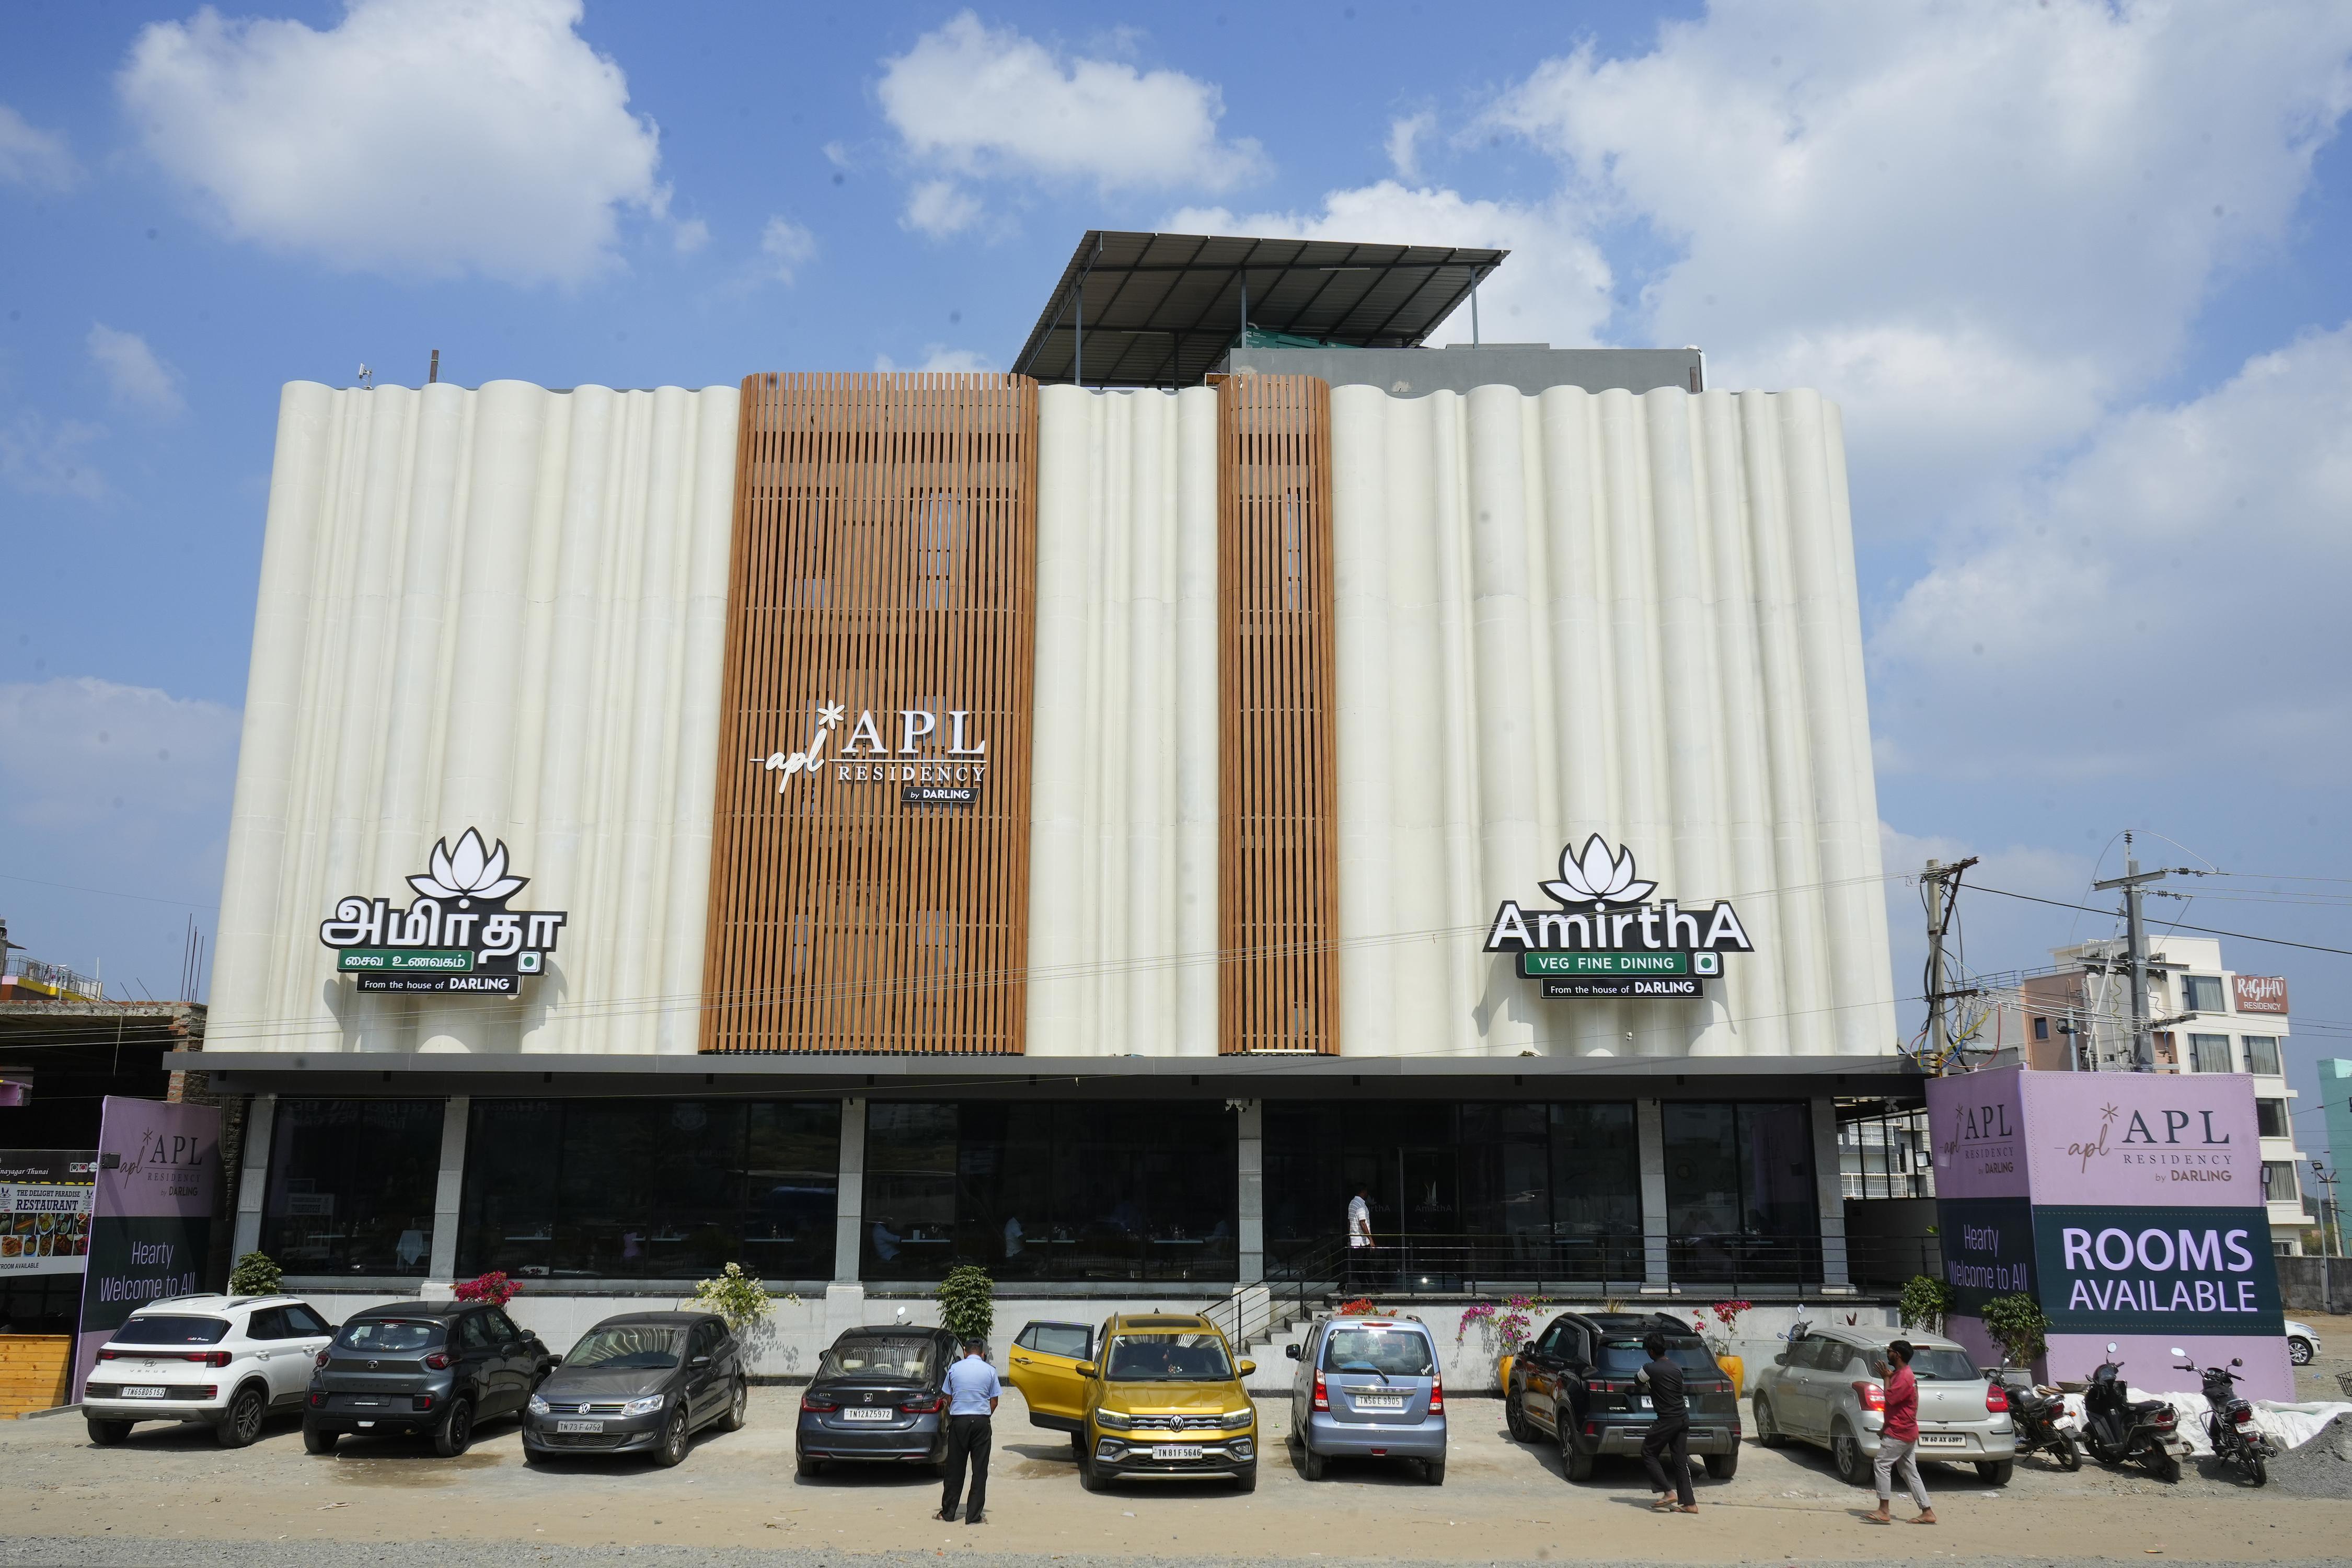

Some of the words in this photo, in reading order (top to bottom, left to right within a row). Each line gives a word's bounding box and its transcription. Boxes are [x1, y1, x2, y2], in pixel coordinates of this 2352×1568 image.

[840, 709, 986, 754] APL
[765, 728, 828, 794] apl
[838, 766, 986, 782] RESIDENCY
[910, 791, 919, 800] by
[923, 789, 970, 799] DARLING
[321, 897, 563, 965] அமிர்தா
[1489, 902, 1750, 949] AmirthA
[345, 954, 384, 967] சைவ
[391, 953, 466, 969] உணவகம்
[1538, 957, 1569, 969] VEG
[1578, 957, 1612, 969] FINE
[1621, 957, 1675, 969] DINING
[389, 981, 403, 989] the
[407, 981, 432, 989] house
[435, 981, 444, 989] of
[449, 977, 510, 990] DARLING
[1550, 985, 1572, 994] From
[1575, 985, 1589, 994] the
[1592, 985, 1617, 994] house
[1620, 985, 1630, 994] of
[1634, 981, 1695, 994] DARLING
[2237, 978, 2284, 1001] RAGHAV
[2244, 1001, 2281, 1010] RESIDENCY
[1964, 1104, 2012, 1139] APL
[2122, 1110, 2230, 1144] APL
[149, 1134, 203, 1166] APL
[1965, 1147, 2013, 1159] RESIDENCY
[2068, 1123, 2110, 1174] apl
[1985, 1162, 2013, 1174] DARLING
[2124, 1154, 2232, 1165] RESIDENCY
[0, 1168, 26, 1177] nayagar
[147, 1172, 201, 1183] RESIDENCY
[2155, 1173, 2166, 1183] by
[2171, 1170, 2232, 1182] DARLING
[169, 1186, 198, 1196] DARLING
[16, 1199, 79, 1210] RESTAURANT
[1964, 1224, 1999, 1258] Hearty
[2062, 1227, 2253, 1272] ROOMS
[131, 1241, 174, 1270] Hearty
[1948, 1260, 1993, 1289] Welcome
[1996, 1264, 2009, 1290] to
[2012, 1263, 2027, 1291] All
[101, 1275, 162, 1302] Welcome
[166, 1275, 178, 1297] to
[180, 1272, 195, 1296] All
[2069, 1279, 2258, 1312] AVAILABLE
